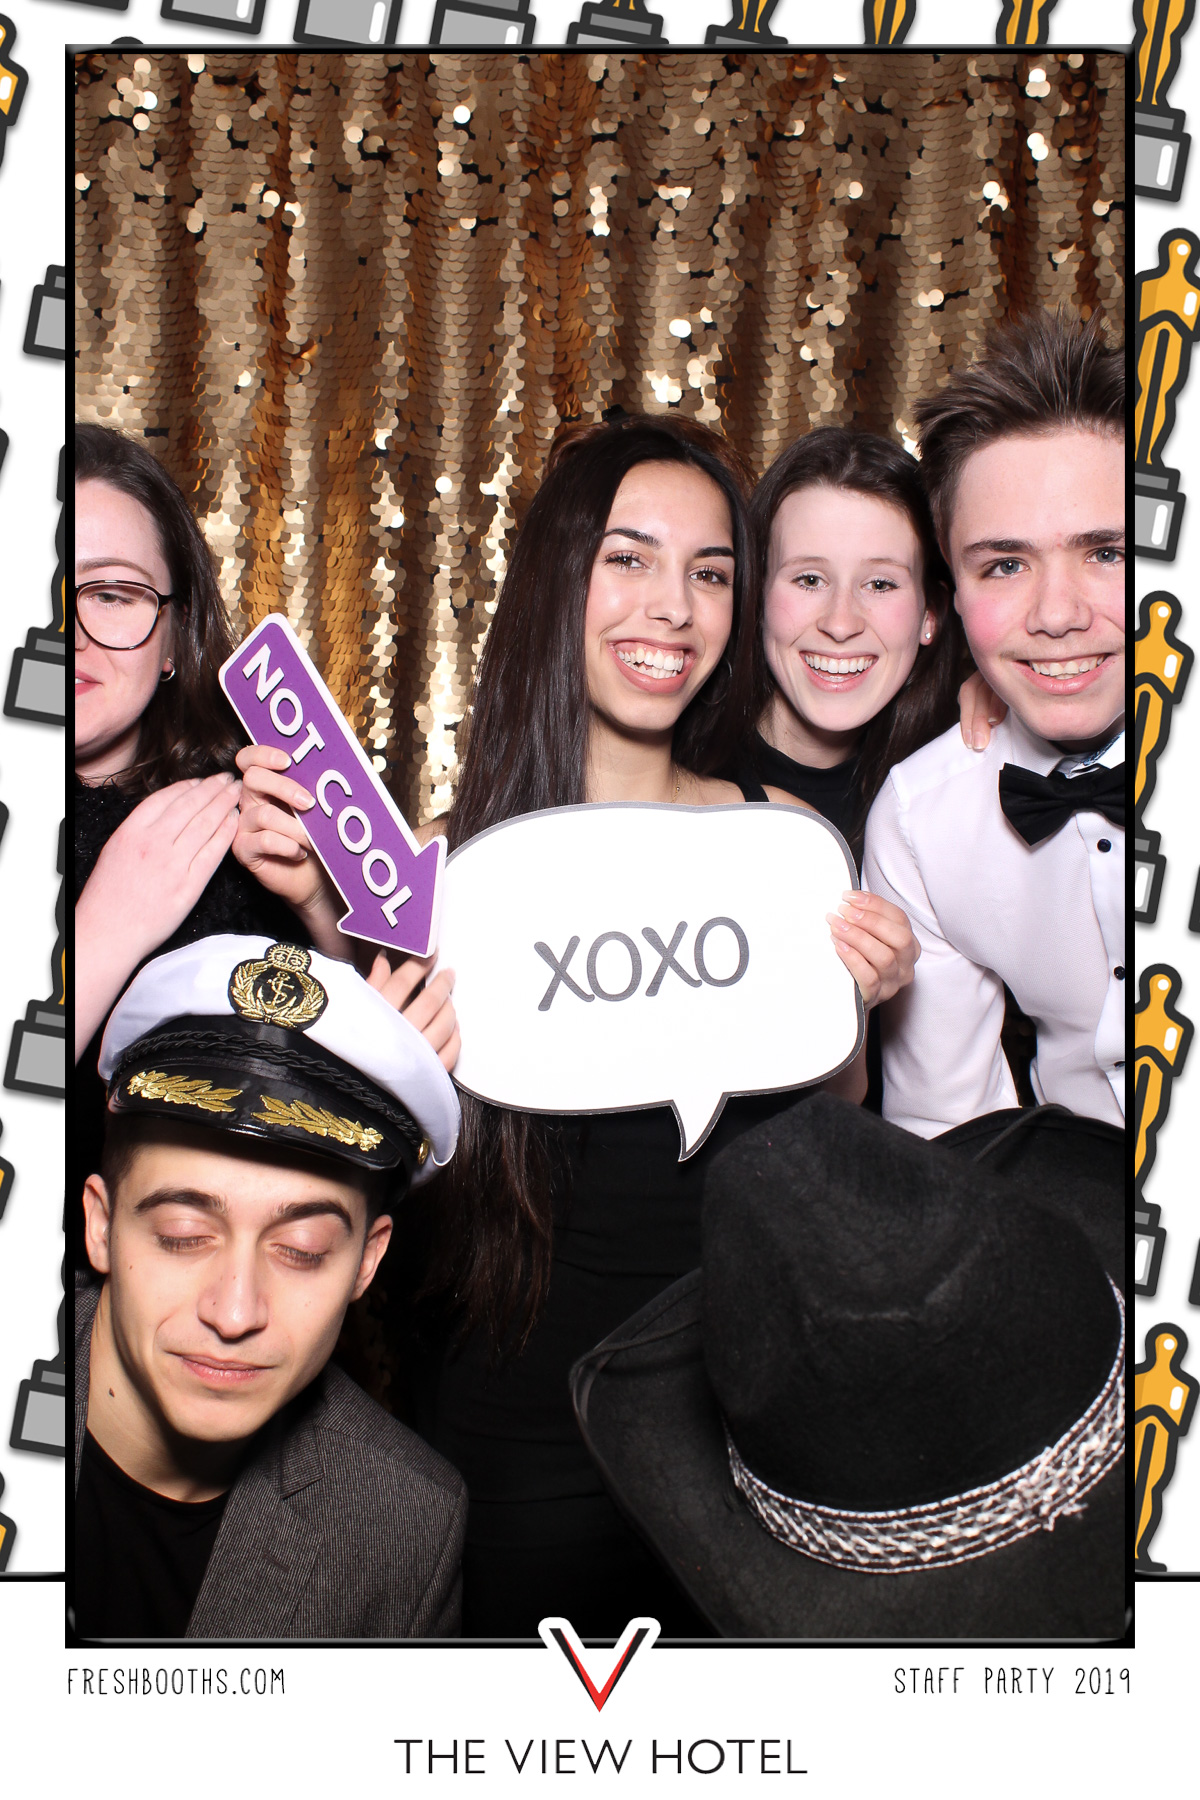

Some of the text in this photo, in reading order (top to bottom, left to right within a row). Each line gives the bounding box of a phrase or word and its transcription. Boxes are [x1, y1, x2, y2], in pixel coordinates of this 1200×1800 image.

[242, 643, 413, 929] NOT COOL
[534, 916, 750, 1012] XOXO
